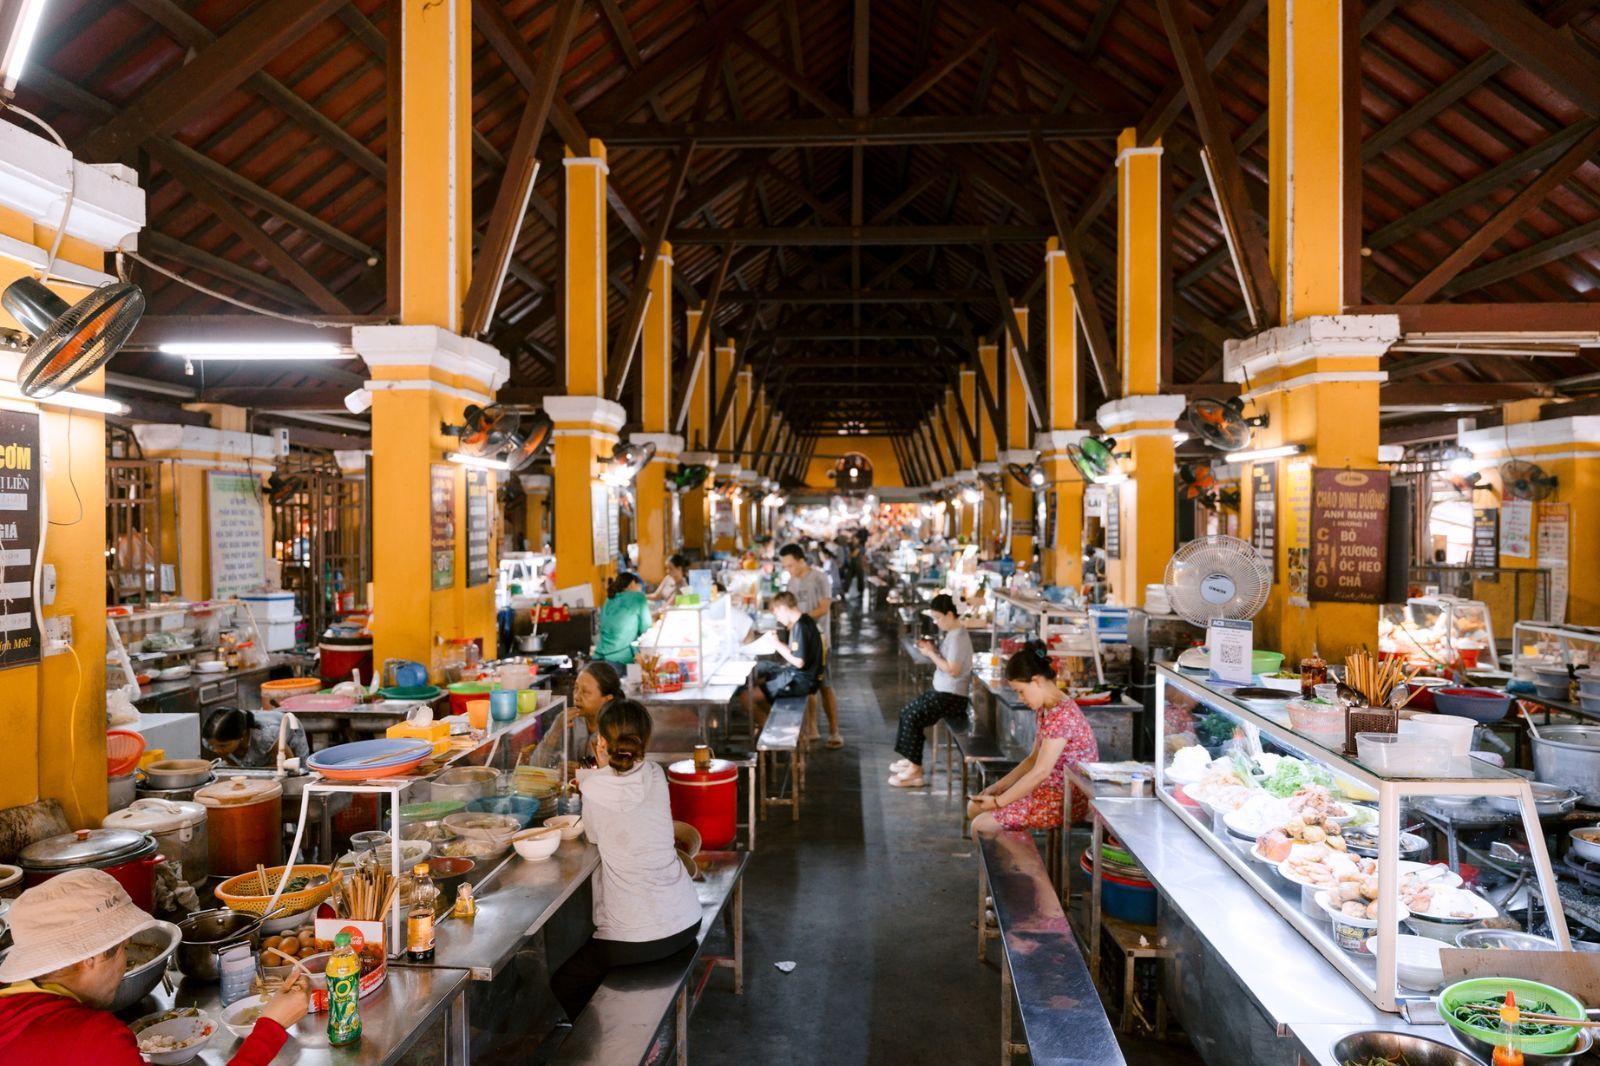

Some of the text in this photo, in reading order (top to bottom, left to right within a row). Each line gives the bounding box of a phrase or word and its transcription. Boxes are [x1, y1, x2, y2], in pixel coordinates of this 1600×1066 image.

[6, 473, 30, 490] LIÊN
[1316, 487, 1386, 511] CHÁO DINH DƯỠNG
[1323, 510, 1344, 519] ANH
[1339, 544, 1378, 557] XƯƠNG
[1358, 560, 1382, 573] HEO
[13, 636, 32, 650] Mời!
